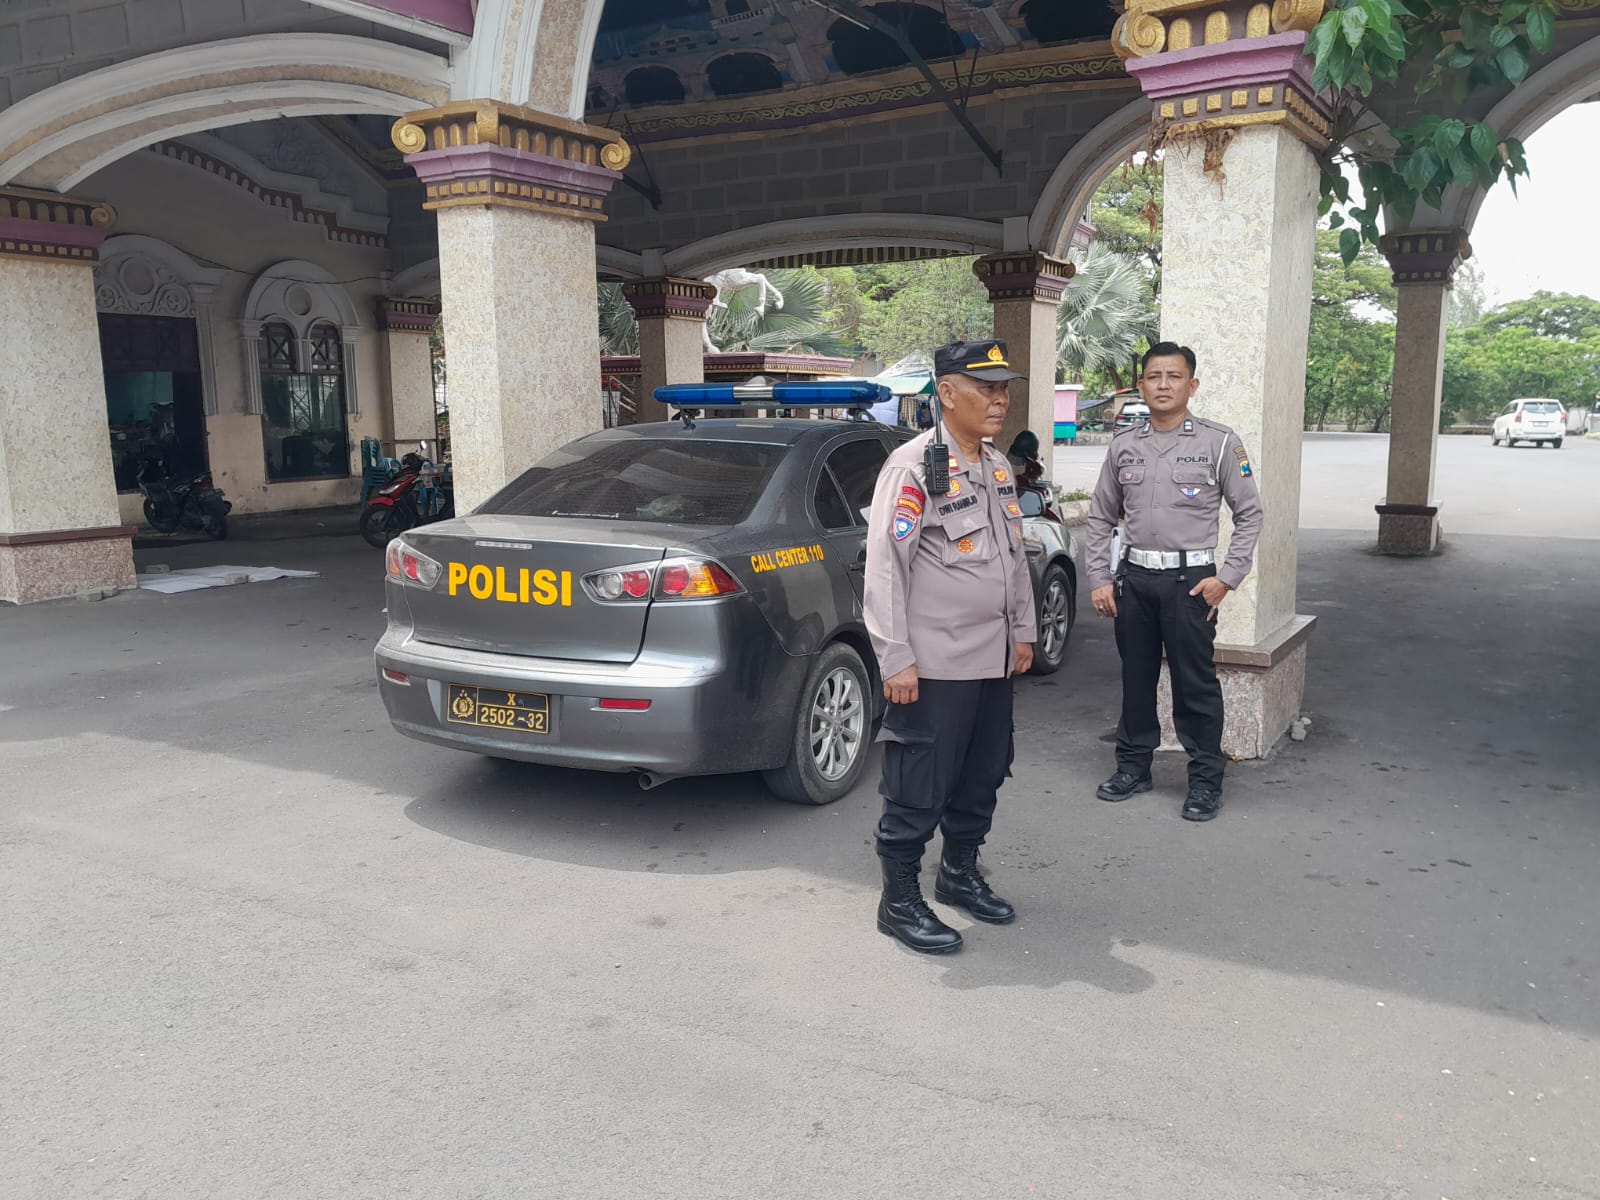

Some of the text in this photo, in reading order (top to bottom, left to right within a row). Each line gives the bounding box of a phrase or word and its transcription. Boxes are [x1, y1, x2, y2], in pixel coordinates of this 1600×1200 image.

[751, 544, 825, 574] CALL CENTER 110
[448, 562, 572, 607] POLISI
[507, 692, 516, 706] X
